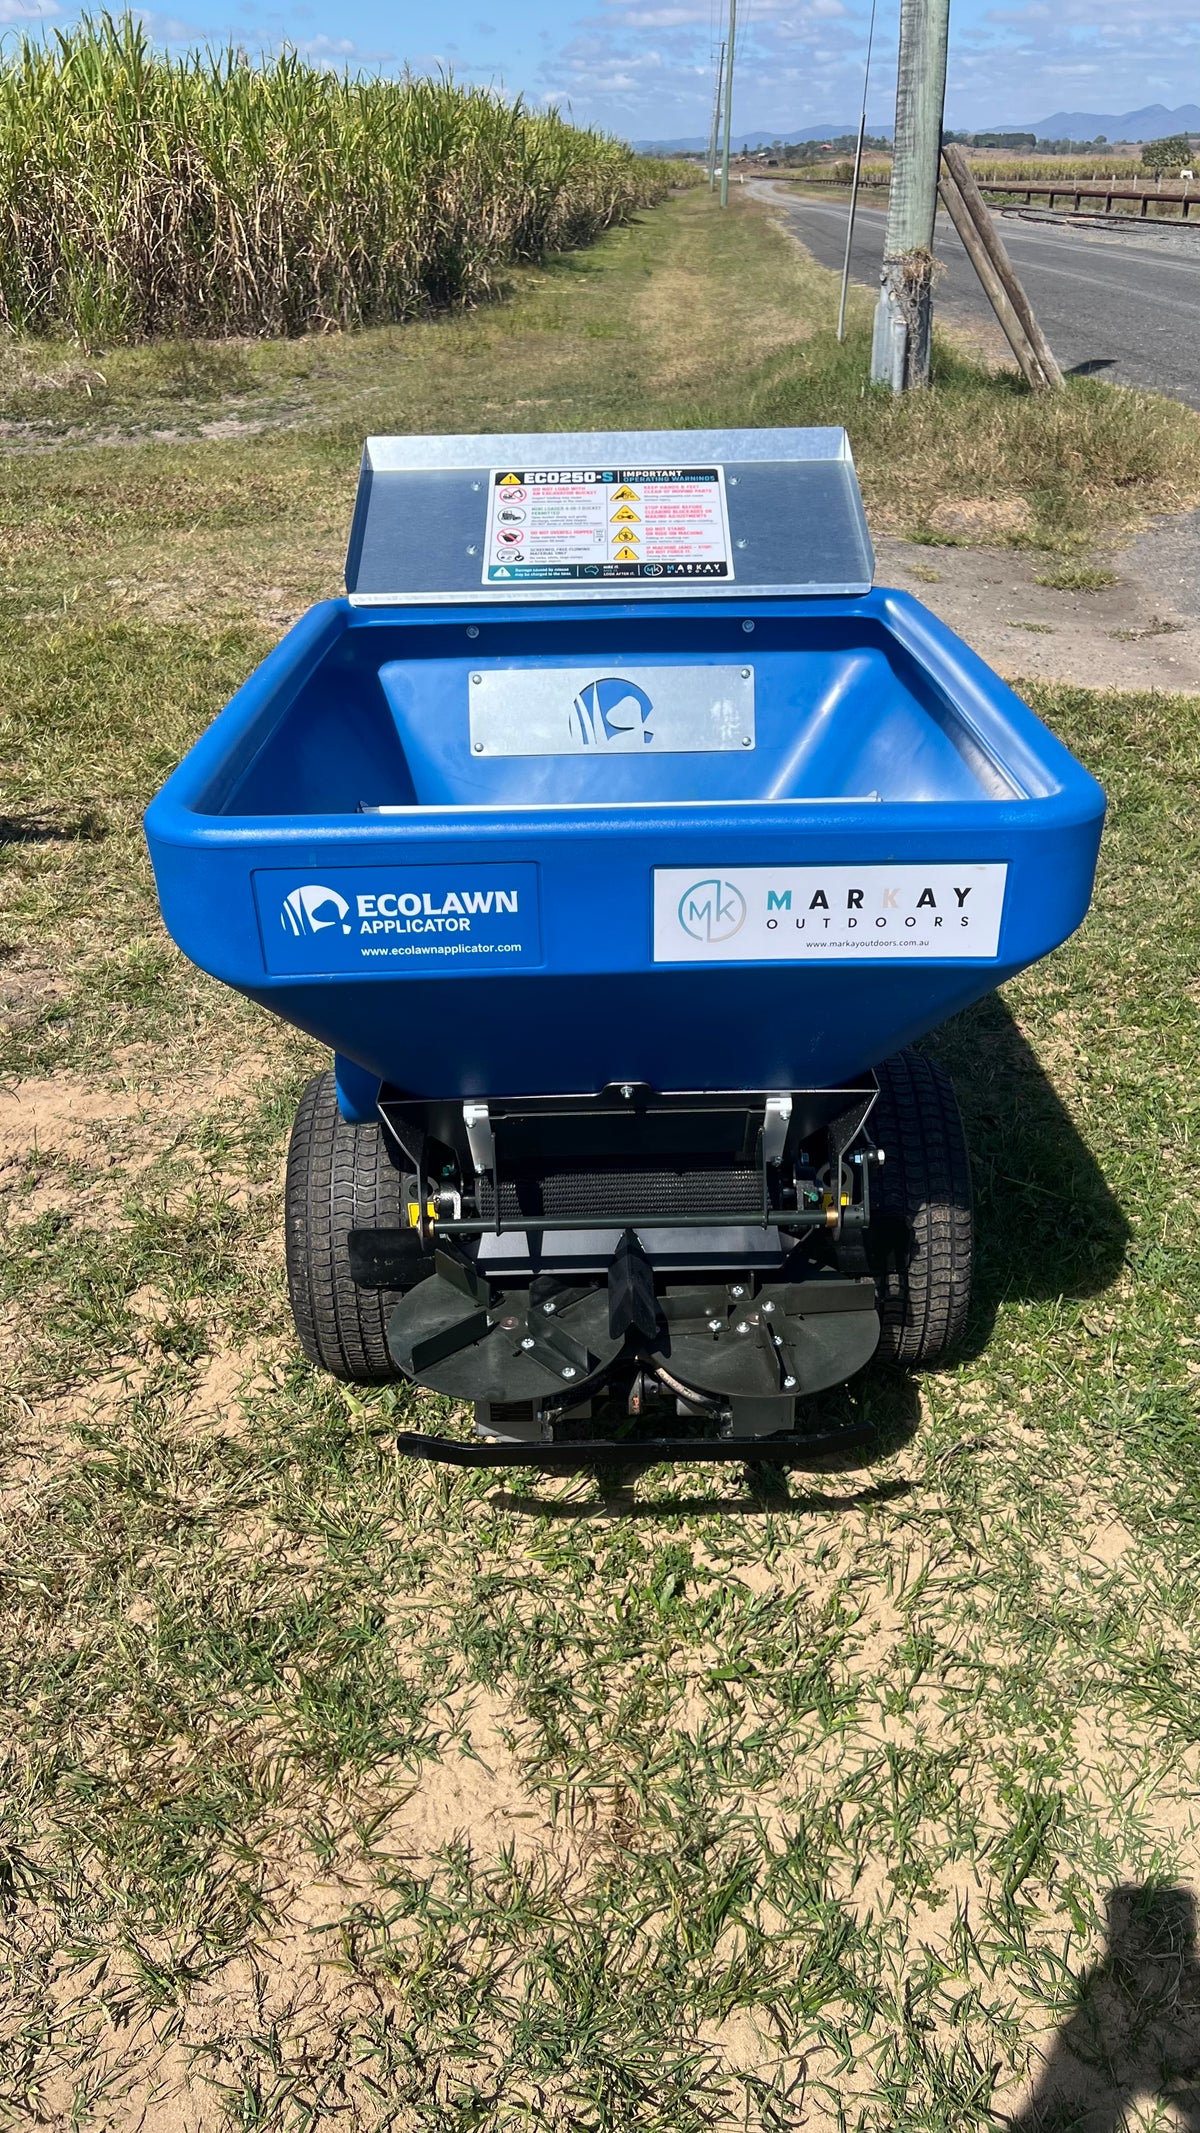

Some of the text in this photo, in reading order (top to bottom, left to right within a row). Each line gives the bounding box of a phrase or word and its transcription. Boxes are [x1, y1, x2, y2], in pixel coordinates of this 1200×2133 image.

[523, 471, 614, 484] ECO250-S
[666, 563, 720, 571] MARKAY
[356, 890, 518, 917] ECOLAWN
[767, 887, 972, 910] MARKAY
[360, 918, 471, 934] APPLICATOR
[766, 916, 969, 930] OUTDOORS
[361, 943, 522, 957] www.ecolawnapplicator.com
[806, 938, 930, 949] www.markayoutdoors.com.au
